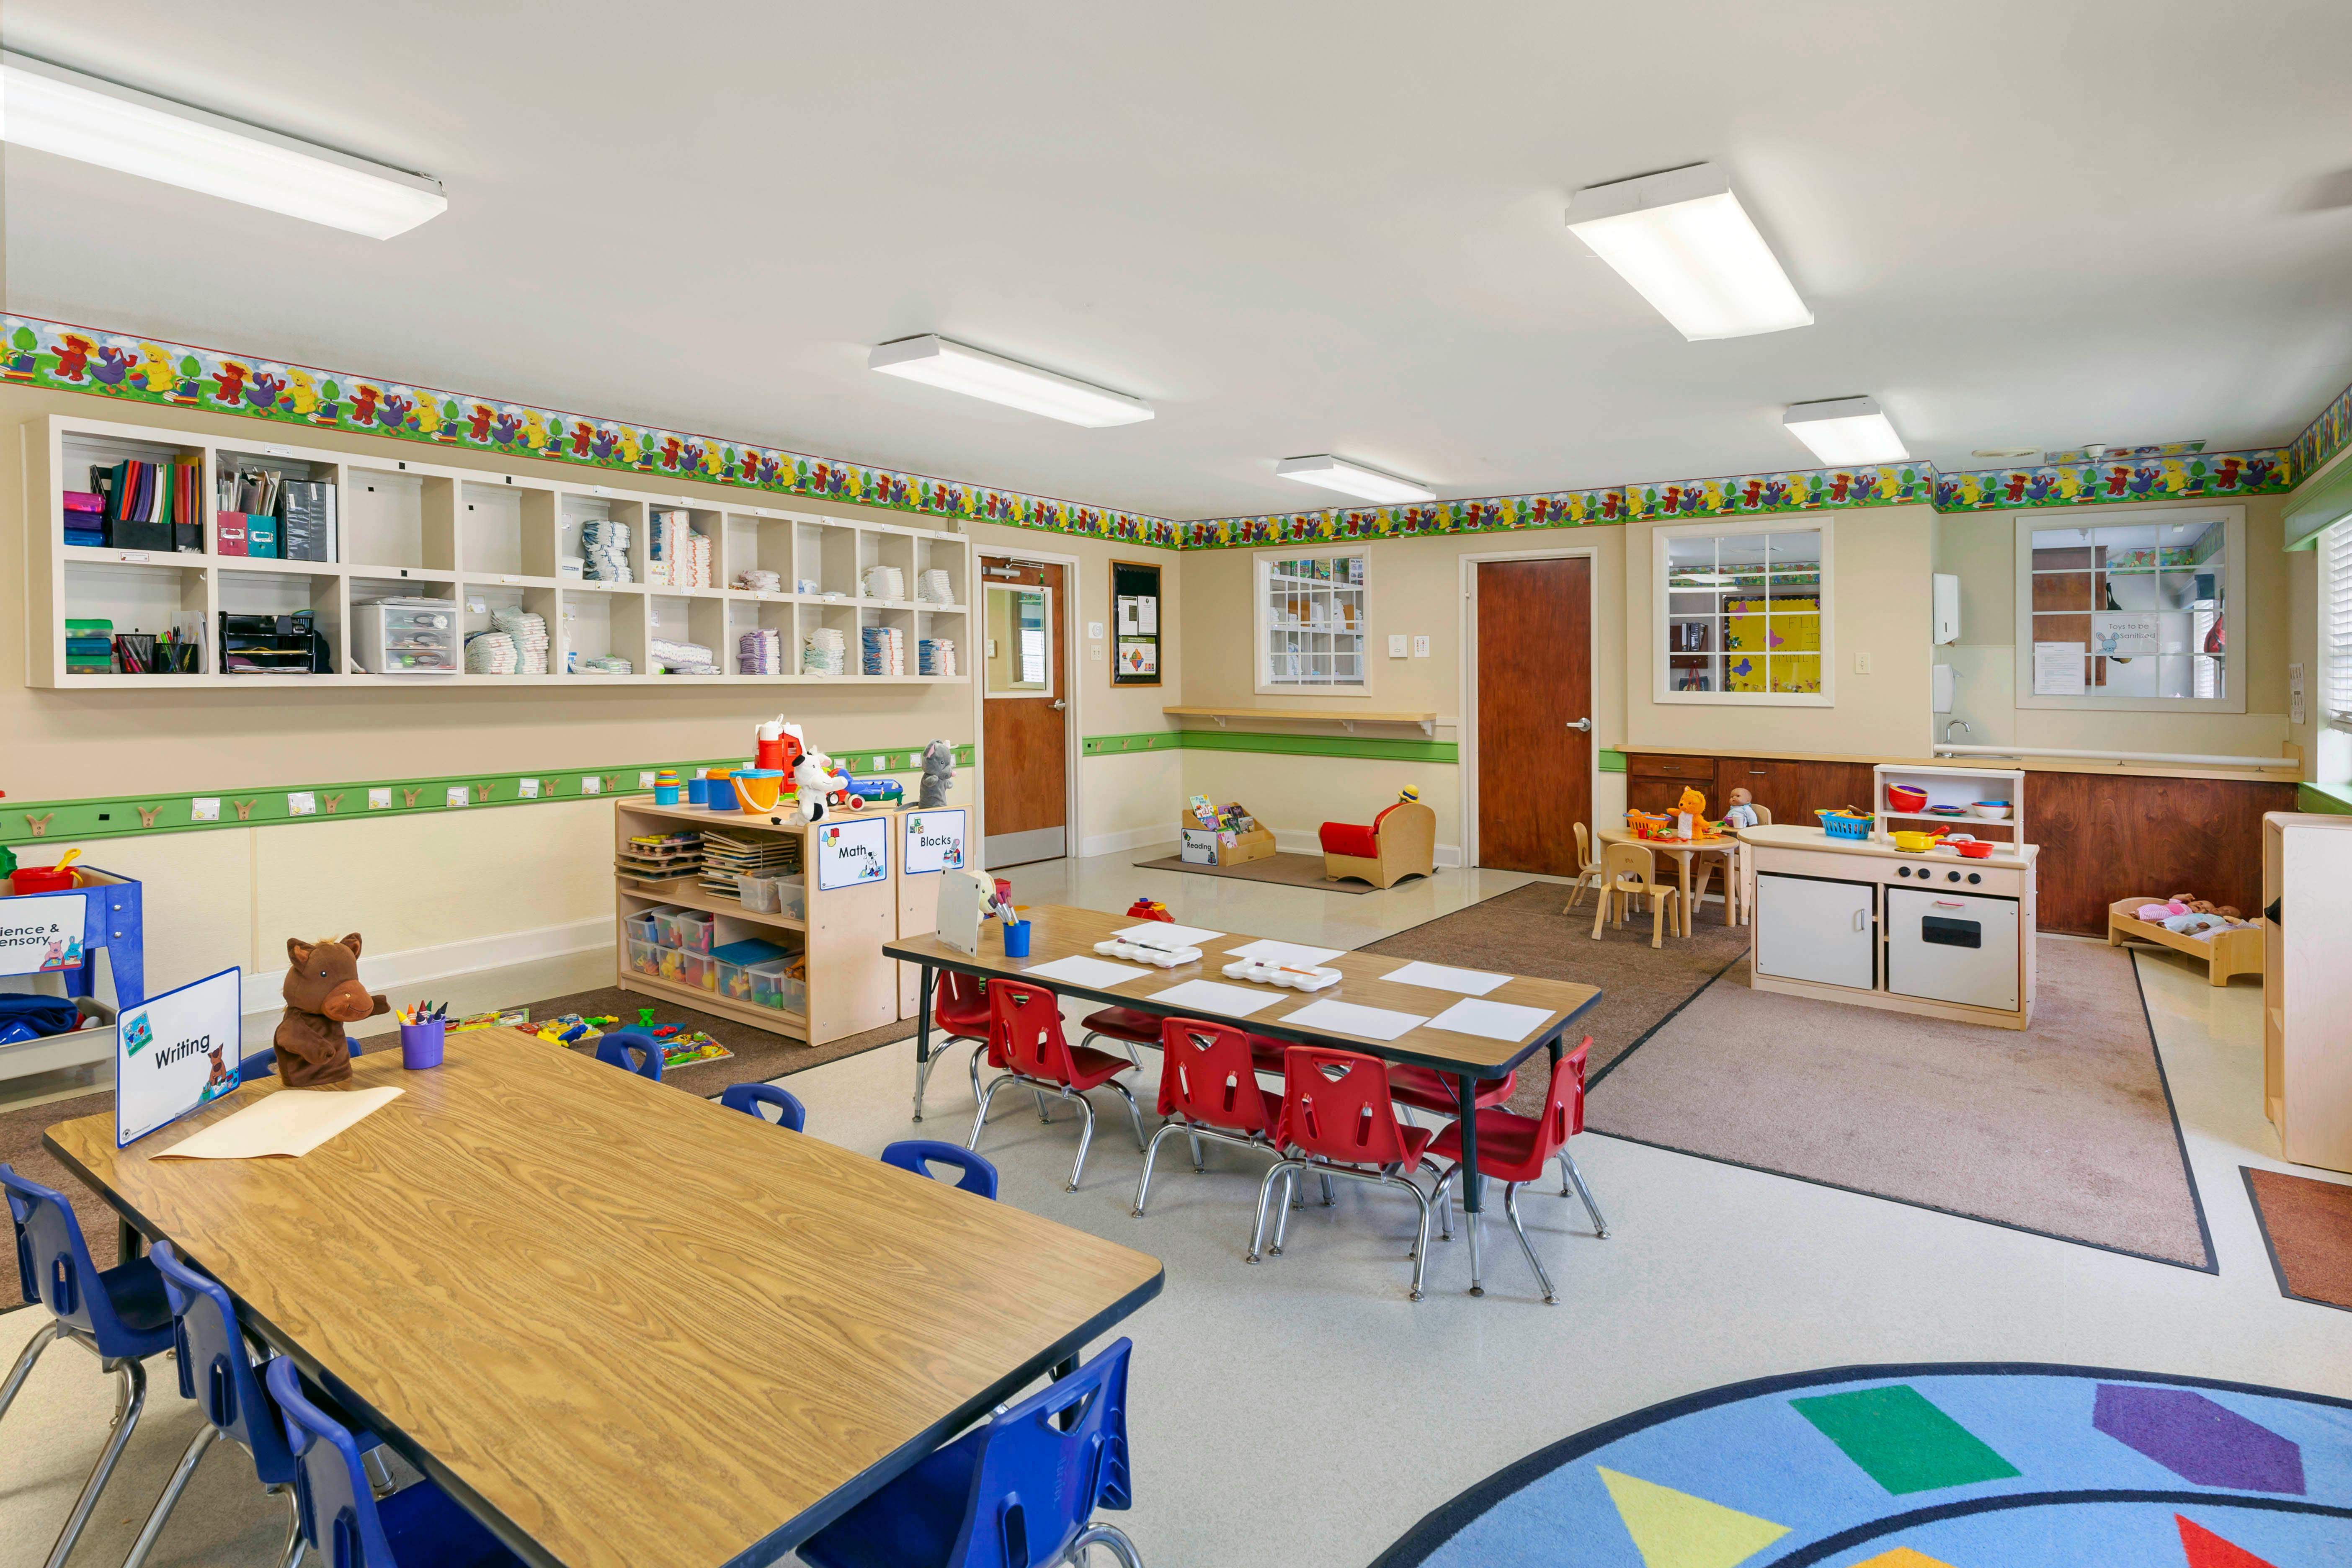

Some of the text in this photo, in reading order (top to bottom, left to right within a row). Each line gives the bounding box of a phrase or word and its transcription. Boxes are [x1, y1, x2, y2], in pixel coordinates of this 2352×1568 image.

[921, 835, 951, 847] Blocks
[1187, 842, 1212, 851] Reading
[838, 844, 866, 859] Math
[50, 923, 59, 933] &
[155, 1034, 210, 1069] Writing
